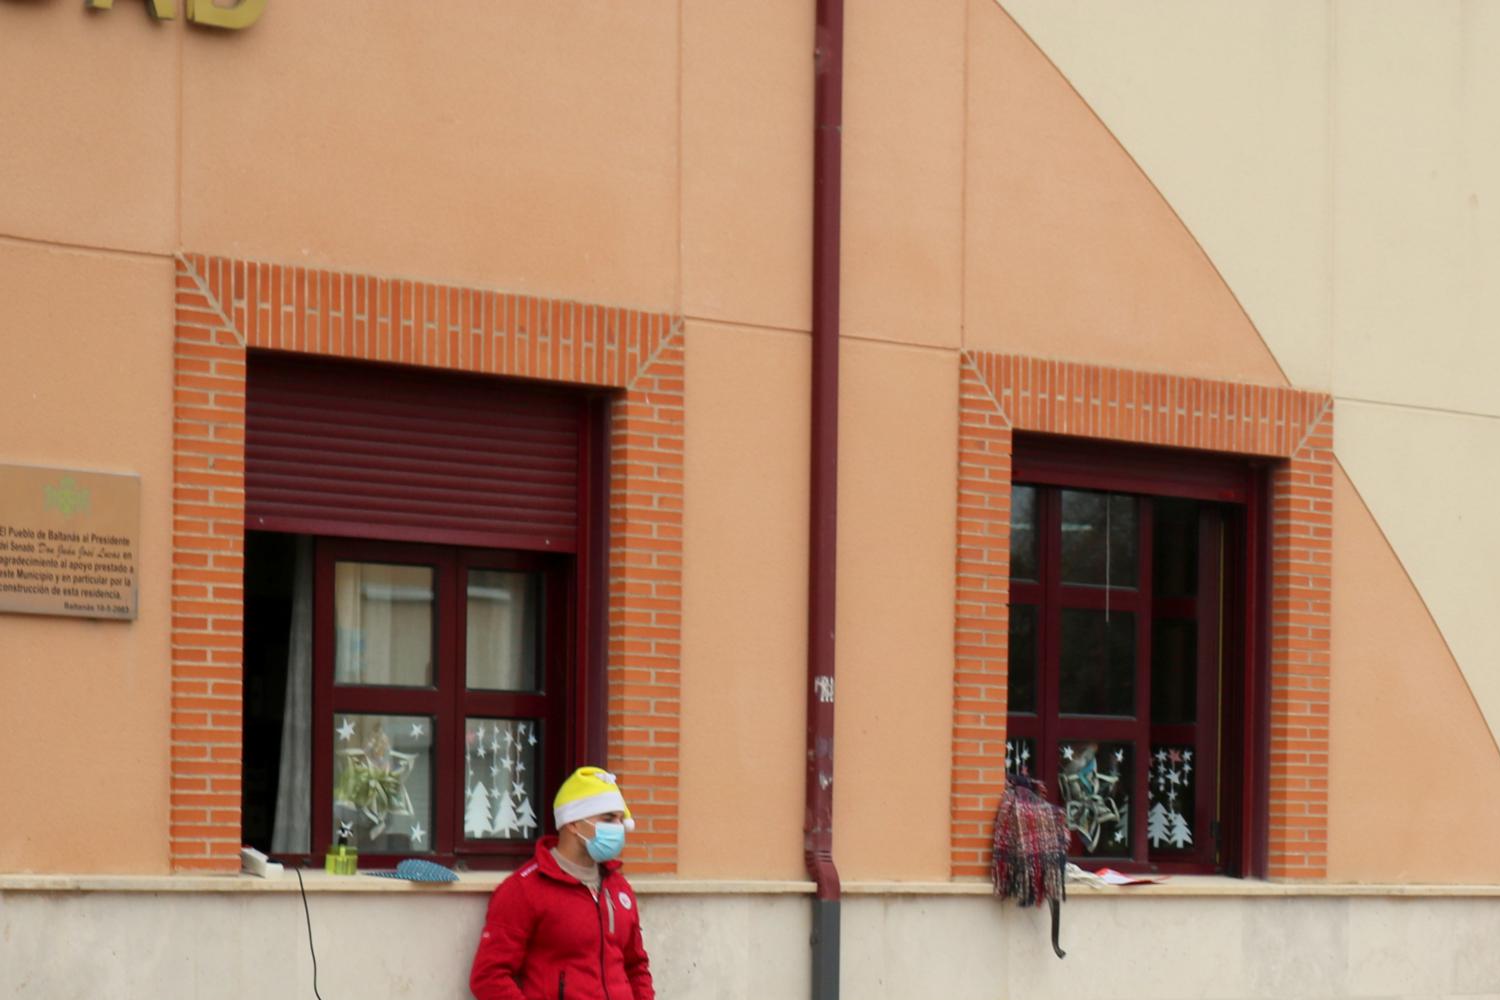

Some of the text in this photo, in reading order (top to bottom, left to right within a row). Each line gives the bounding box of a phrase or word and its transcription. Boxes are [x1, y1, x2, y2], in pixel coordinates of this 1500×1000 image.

[9, 527, 35, 539] Pueblo
[91, 533, 130, 546] Presidente
[70, 562, 92, 573] apoyo
[95, 563, 128, 574] prestado
[73, 575, 107, 586] particular
[111, 578, 121, 588] por
[63, 588, 79, 597] esta
